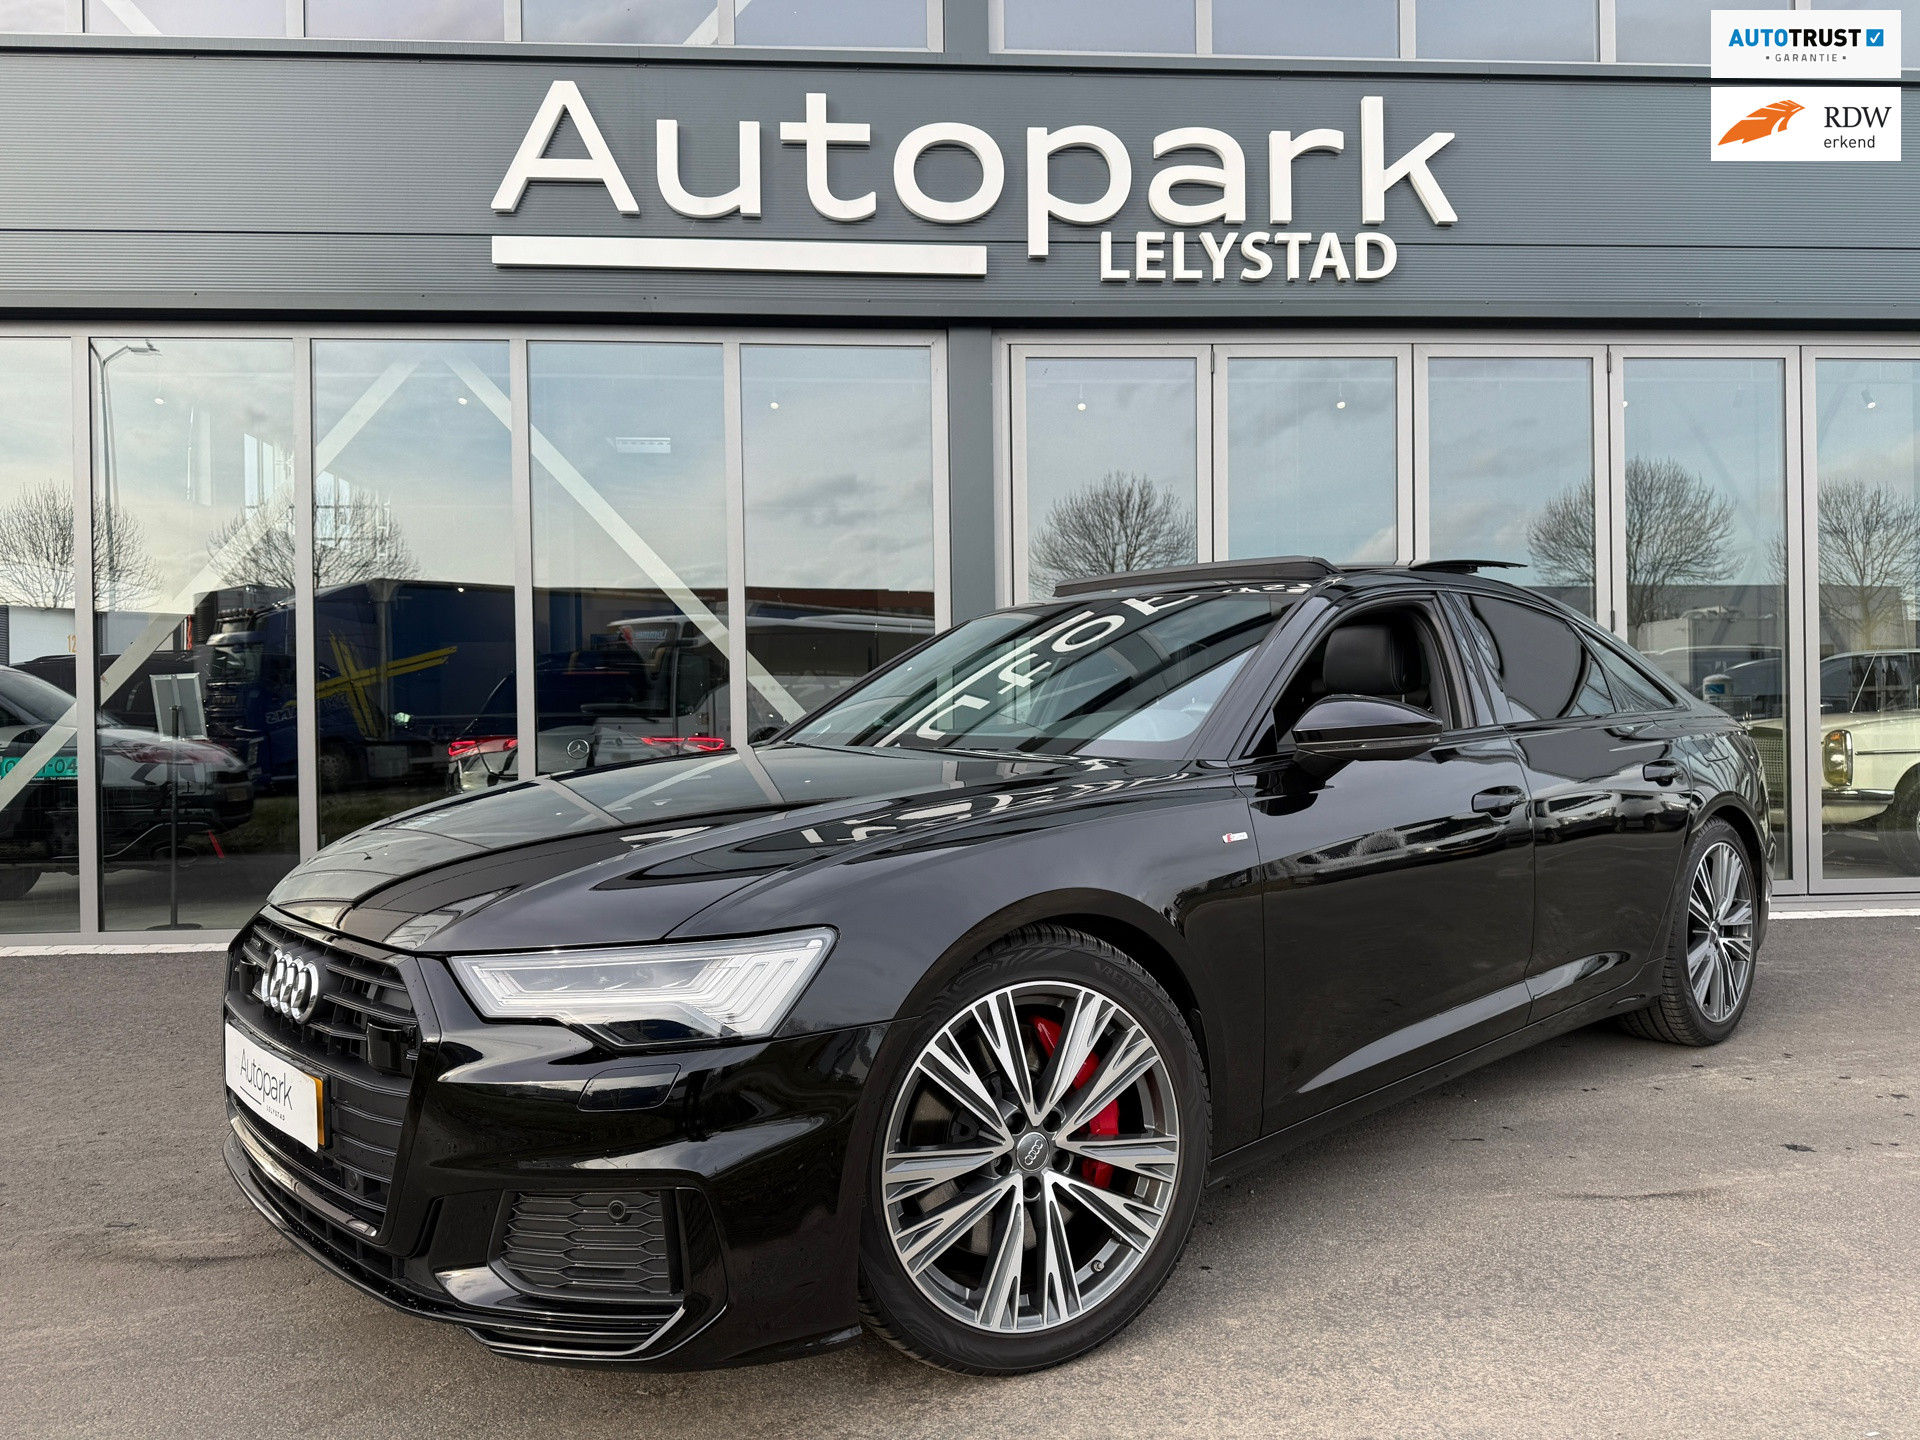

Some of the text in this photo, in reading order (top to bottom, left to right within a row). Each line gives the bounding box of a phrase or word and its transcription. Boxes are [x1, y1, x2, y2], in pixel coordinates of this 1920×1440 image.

[490, 80, 1460, 260] Autopark
[1099, 230, 1399, 283] LELYSTAD
[239, 1048, 293, 1111] Autopark
